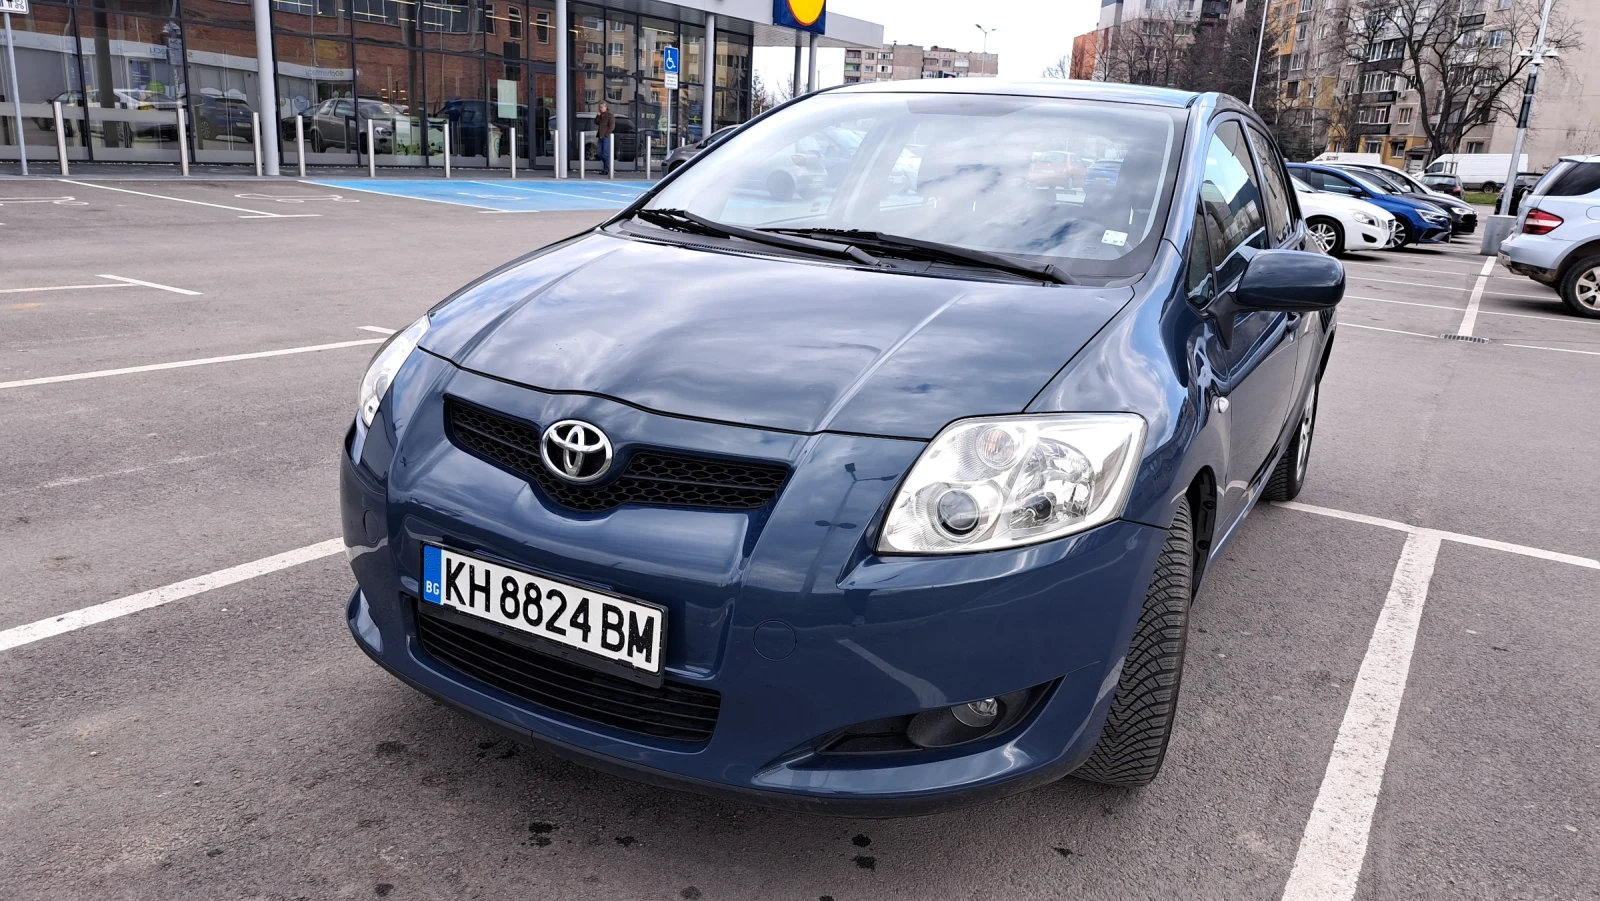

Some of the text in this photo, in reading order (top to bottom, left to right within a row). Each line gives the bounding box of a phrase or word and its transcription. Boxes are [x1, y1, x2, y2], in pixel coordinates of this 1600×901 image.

[425, 580, 440, 596] BG
[445, 557, 655, 664] KH 8824 BM
